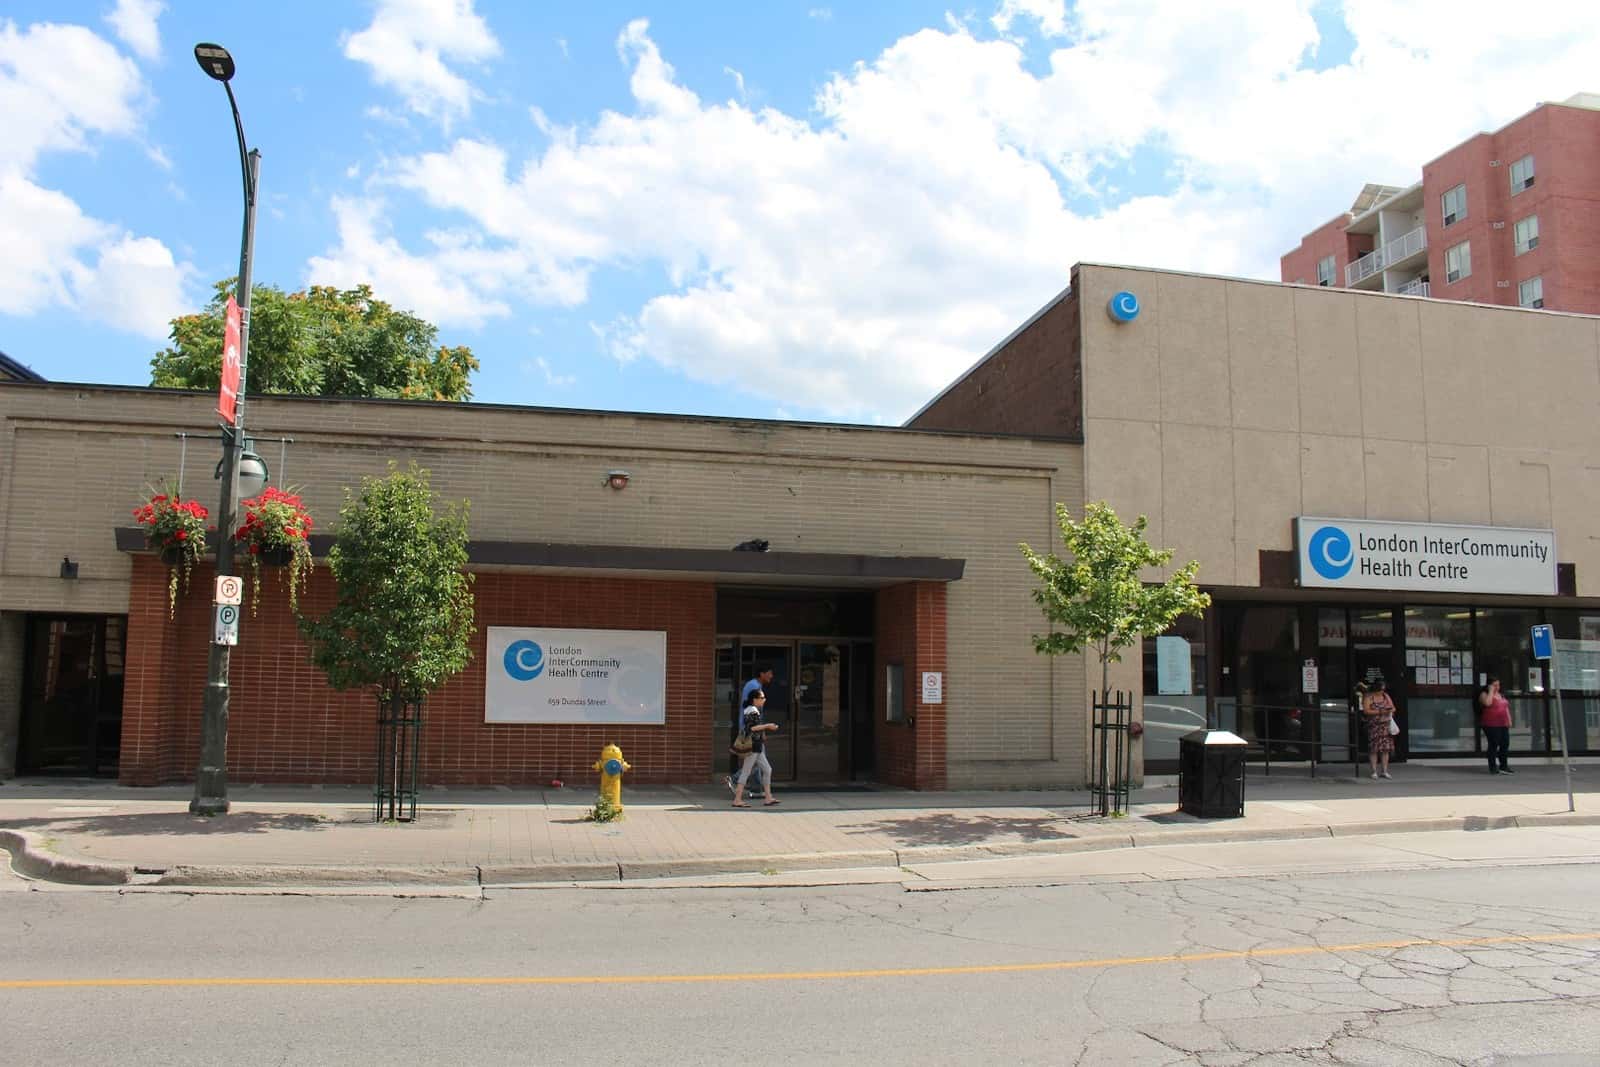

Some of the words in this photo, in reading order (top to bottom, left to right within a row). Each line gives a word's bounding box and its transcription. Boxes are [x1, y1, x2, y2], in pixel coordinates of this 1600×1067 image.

[1359, 533, 1418, 553] London
[1424, 536, 1548, 563] InterCommunity
[1360, 558, 1412, 577] Health
[1418, 560, 1468, 579] Centre
[225, 610, 232, 620] P
[548, 645, 582, 655] London
[548, 657, 621, 669] InterCommunity
[548, 668, 578, 678] Health
[580, 669, 609, 679] Centre
[587, 698, 607, 706] Street
